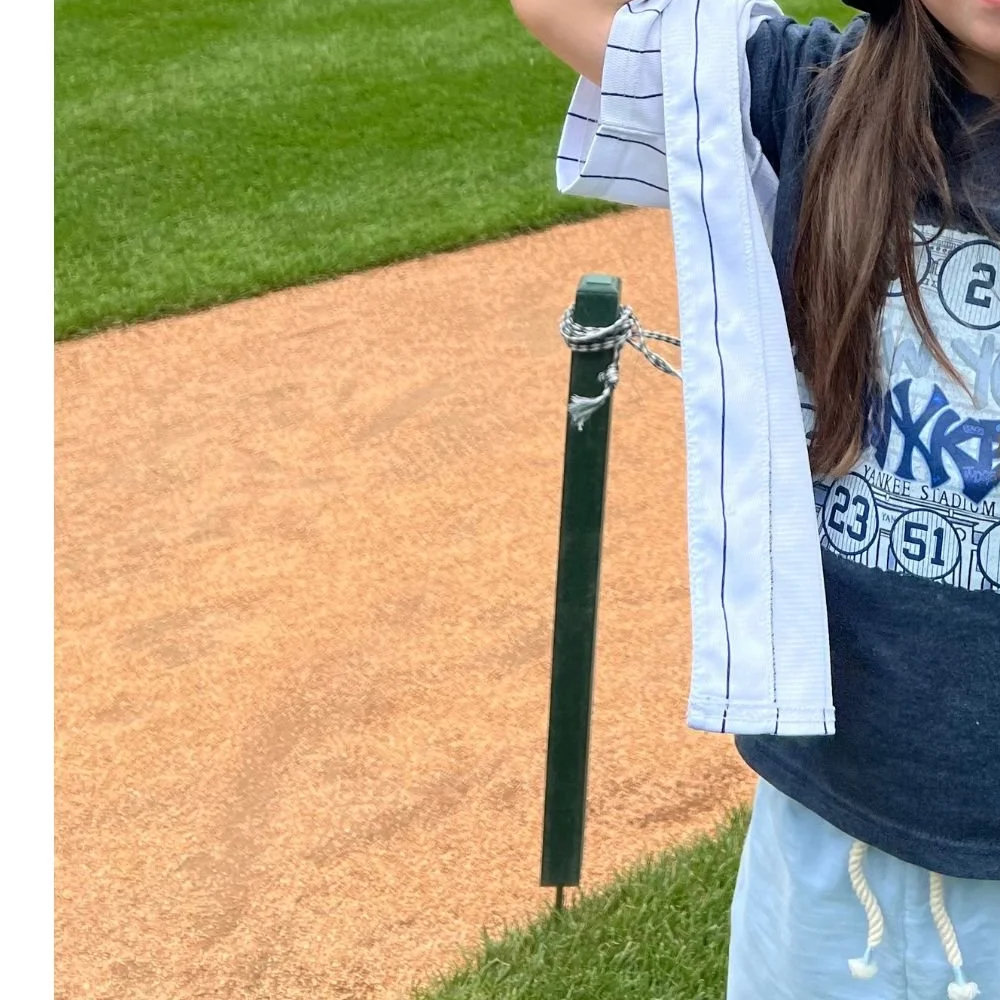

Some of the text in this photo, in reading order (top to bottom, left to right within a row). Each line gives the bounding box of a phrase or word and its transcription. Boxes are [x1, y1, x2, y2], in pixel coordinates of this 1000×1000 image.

[965, 262, 997, 309] 2
[828, 485, 870, 542] 23
[864, 464, 996, 519] YANKEE STADIUM
[902, 520, 945, 567] 51
